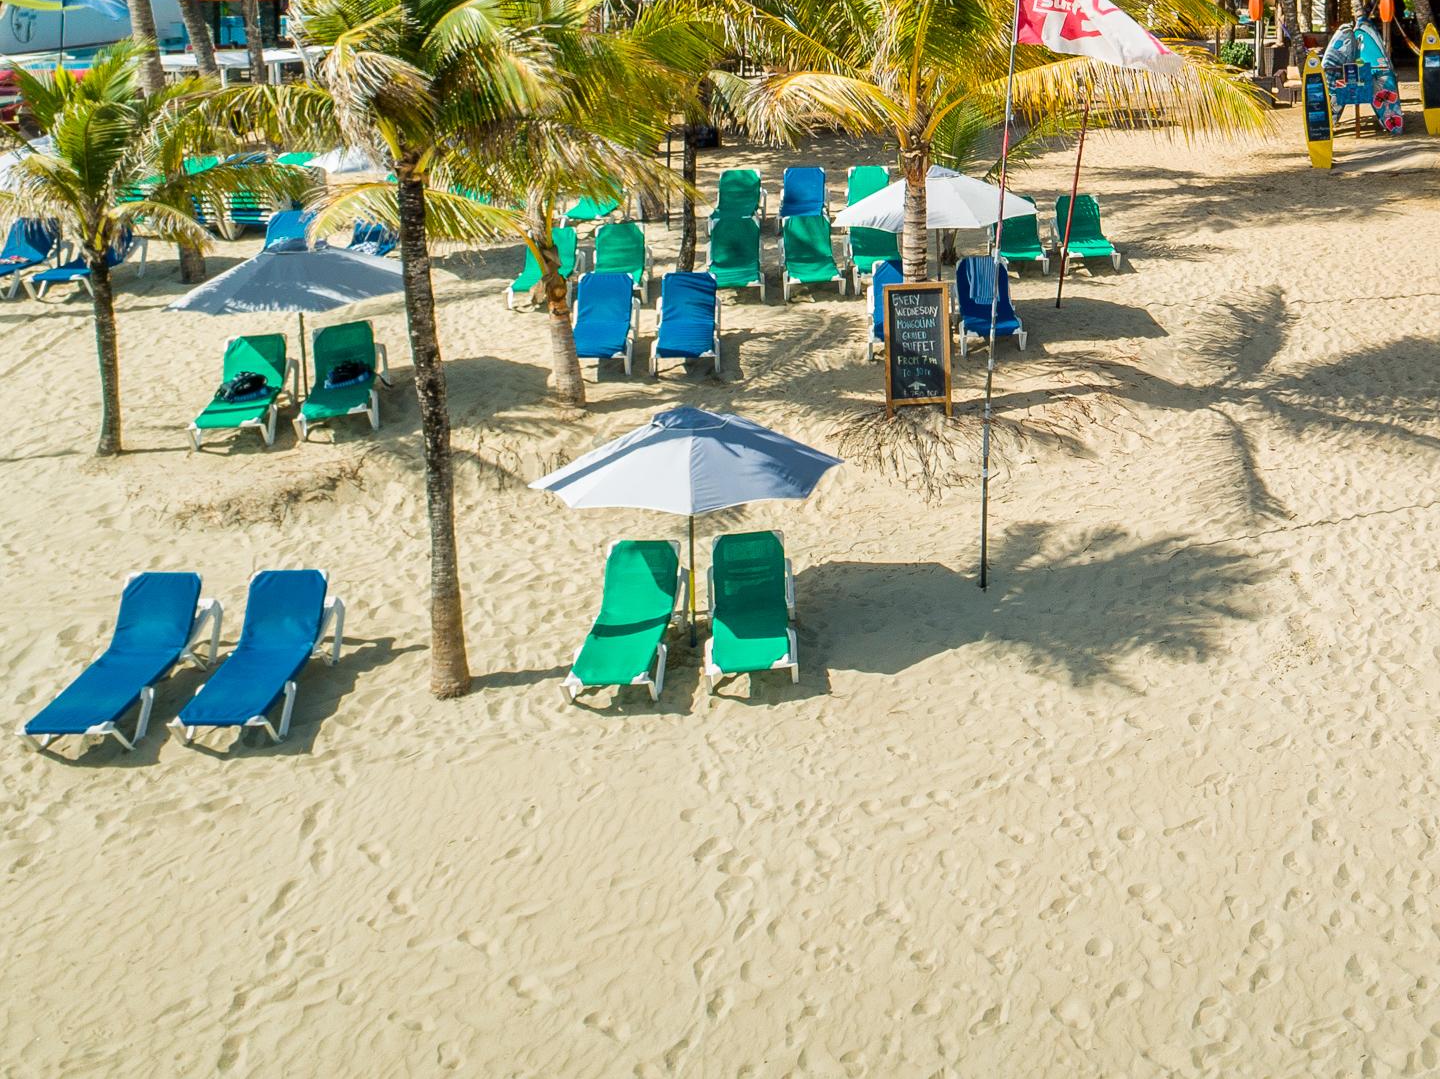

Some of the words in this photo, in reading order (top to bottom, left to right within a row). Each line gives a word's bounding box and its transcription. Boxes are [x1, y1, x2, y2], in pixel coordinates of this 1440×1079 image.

[891, 293, 920, 306] EVERY
[895, 306, 938, 318] WEDNESDAY
[897, 355, 920, 366] FROM
